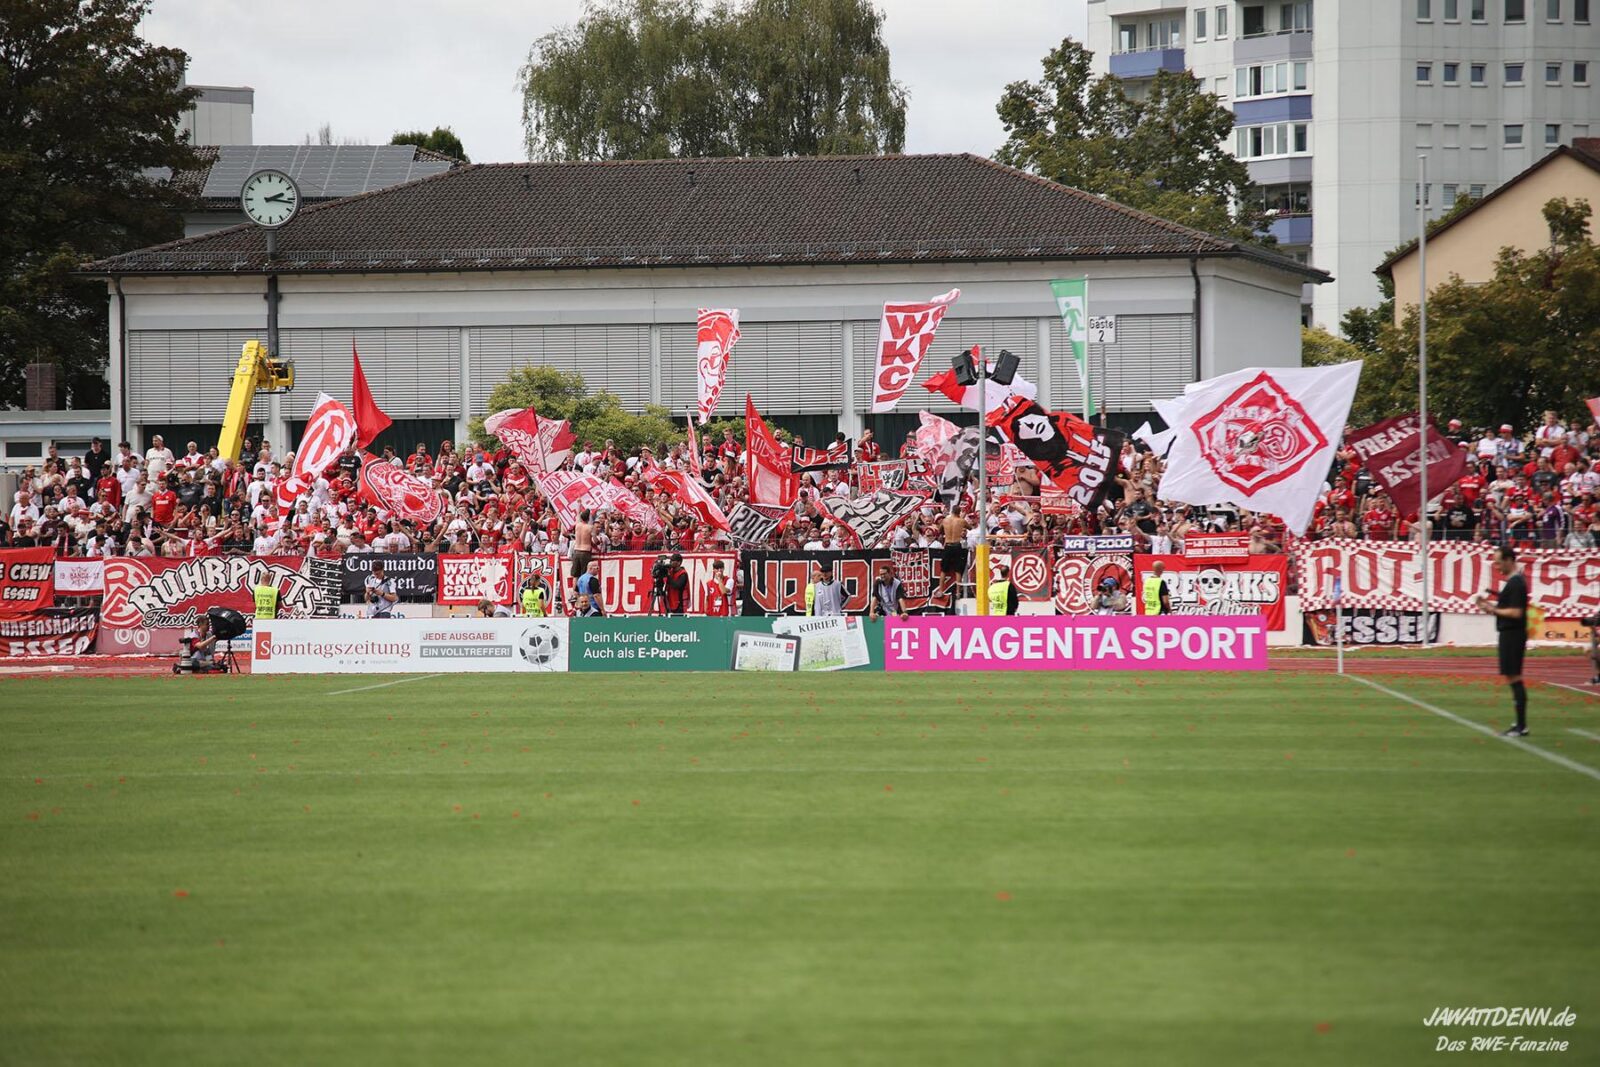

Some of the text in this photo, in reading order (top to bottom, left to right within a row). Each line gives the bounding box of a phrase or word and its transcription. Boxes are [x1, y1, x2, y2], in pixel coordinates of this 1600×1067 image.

[1098, 330, 1105, 342] 2
[1352, 416, 1432, 461] FREAK
[1065, 538, 1133, 549] KAI 2000
[10, 564, 51, 581] CREW
[3, 587, 39, 600] ESSEN
[1141, 571, 1279, 604] REAKS
[798, 618, 839, 634] KURIER
[423, 632, 495, 641] JEDE AUSGABE
[584, 629, 701, 643] Dein Kurier. Überall.
[929, 627, 1125, 660] MAGENTA
[1130, 626, 1261, 660] SPORT
[260, 639, 411, 658] Sonntagszeitung
[422, 646, 510, 656] EIN VOLLTREFFER!
[753, 640, 782, 649] KURIER
[584, 647, 689, 661] Auch als E-Paper.
